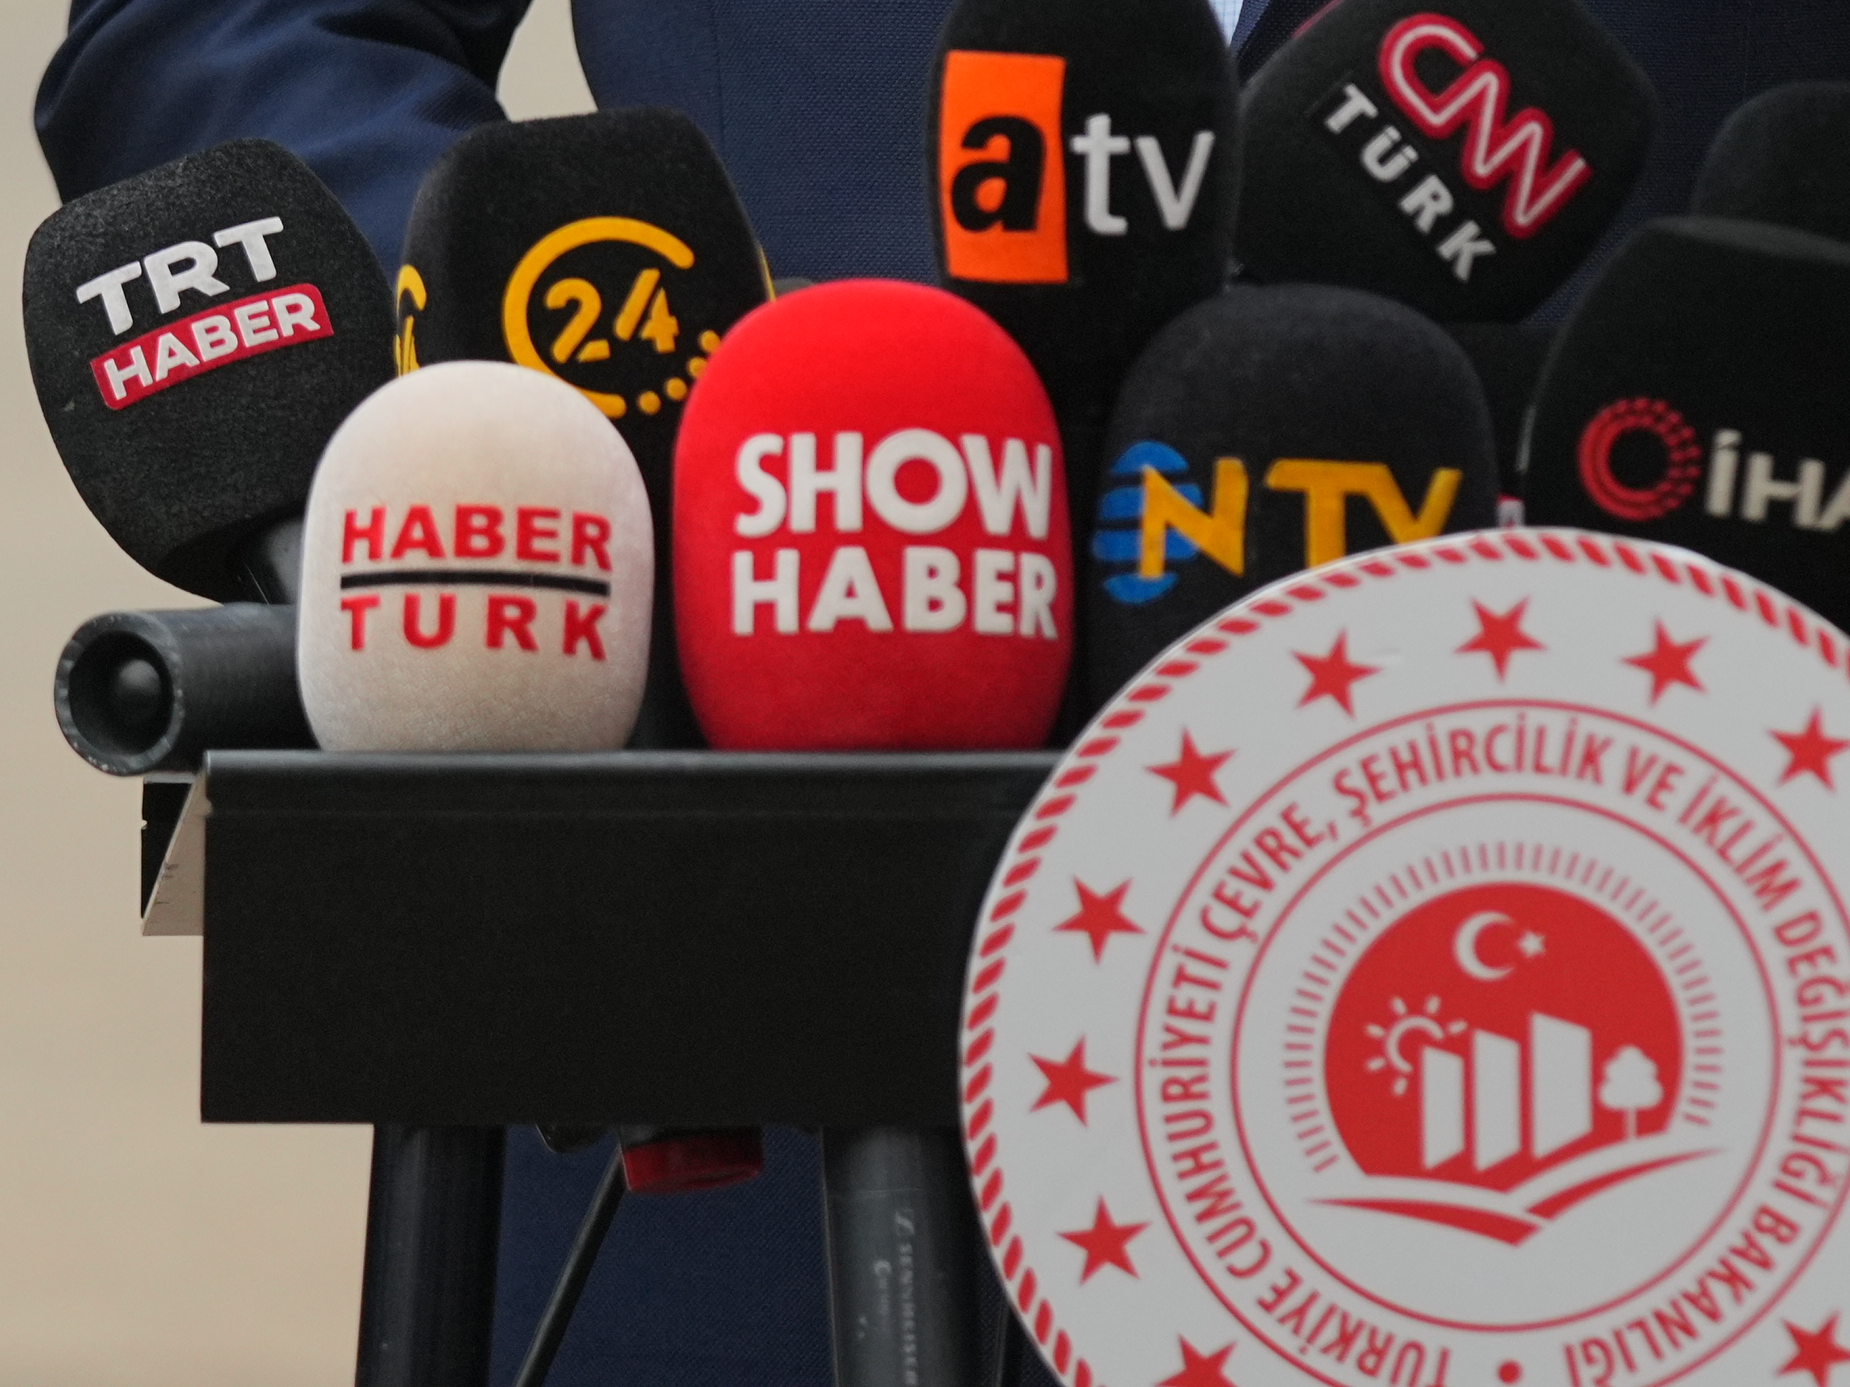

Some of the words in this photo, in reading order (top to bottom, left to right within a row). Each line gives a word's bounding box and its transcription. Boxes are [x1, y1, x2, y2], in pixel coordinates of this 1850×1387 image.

[951, 113, 1216, 236] atv
[1323, 83, 1497, 282] TÜRK
[1378, 12, 1593, 239] CNN
[75, 216, 284, 336] TRT
[544, 267, 680, 364] 24
[103, 292, 321, 401] HABER
[341, 503, 613, 572] HABER
[734, 427, 1053, 541] SHOW
[1138, 456, 1463, 579] NTV
[340, 592, 609, 661] TURK
[732, 545, 1059, 640] HABER
[1332, 712, 1615, 829] ŞEHİRCİLİK
[1623, 745, 1686, 811] VE
[1201, 801, 1339, 944] ÇEVRE,
[1678, 771, 1802, 912] İKLİM
[1149, 943, 1273, 1279] CUMHURİYETİ
